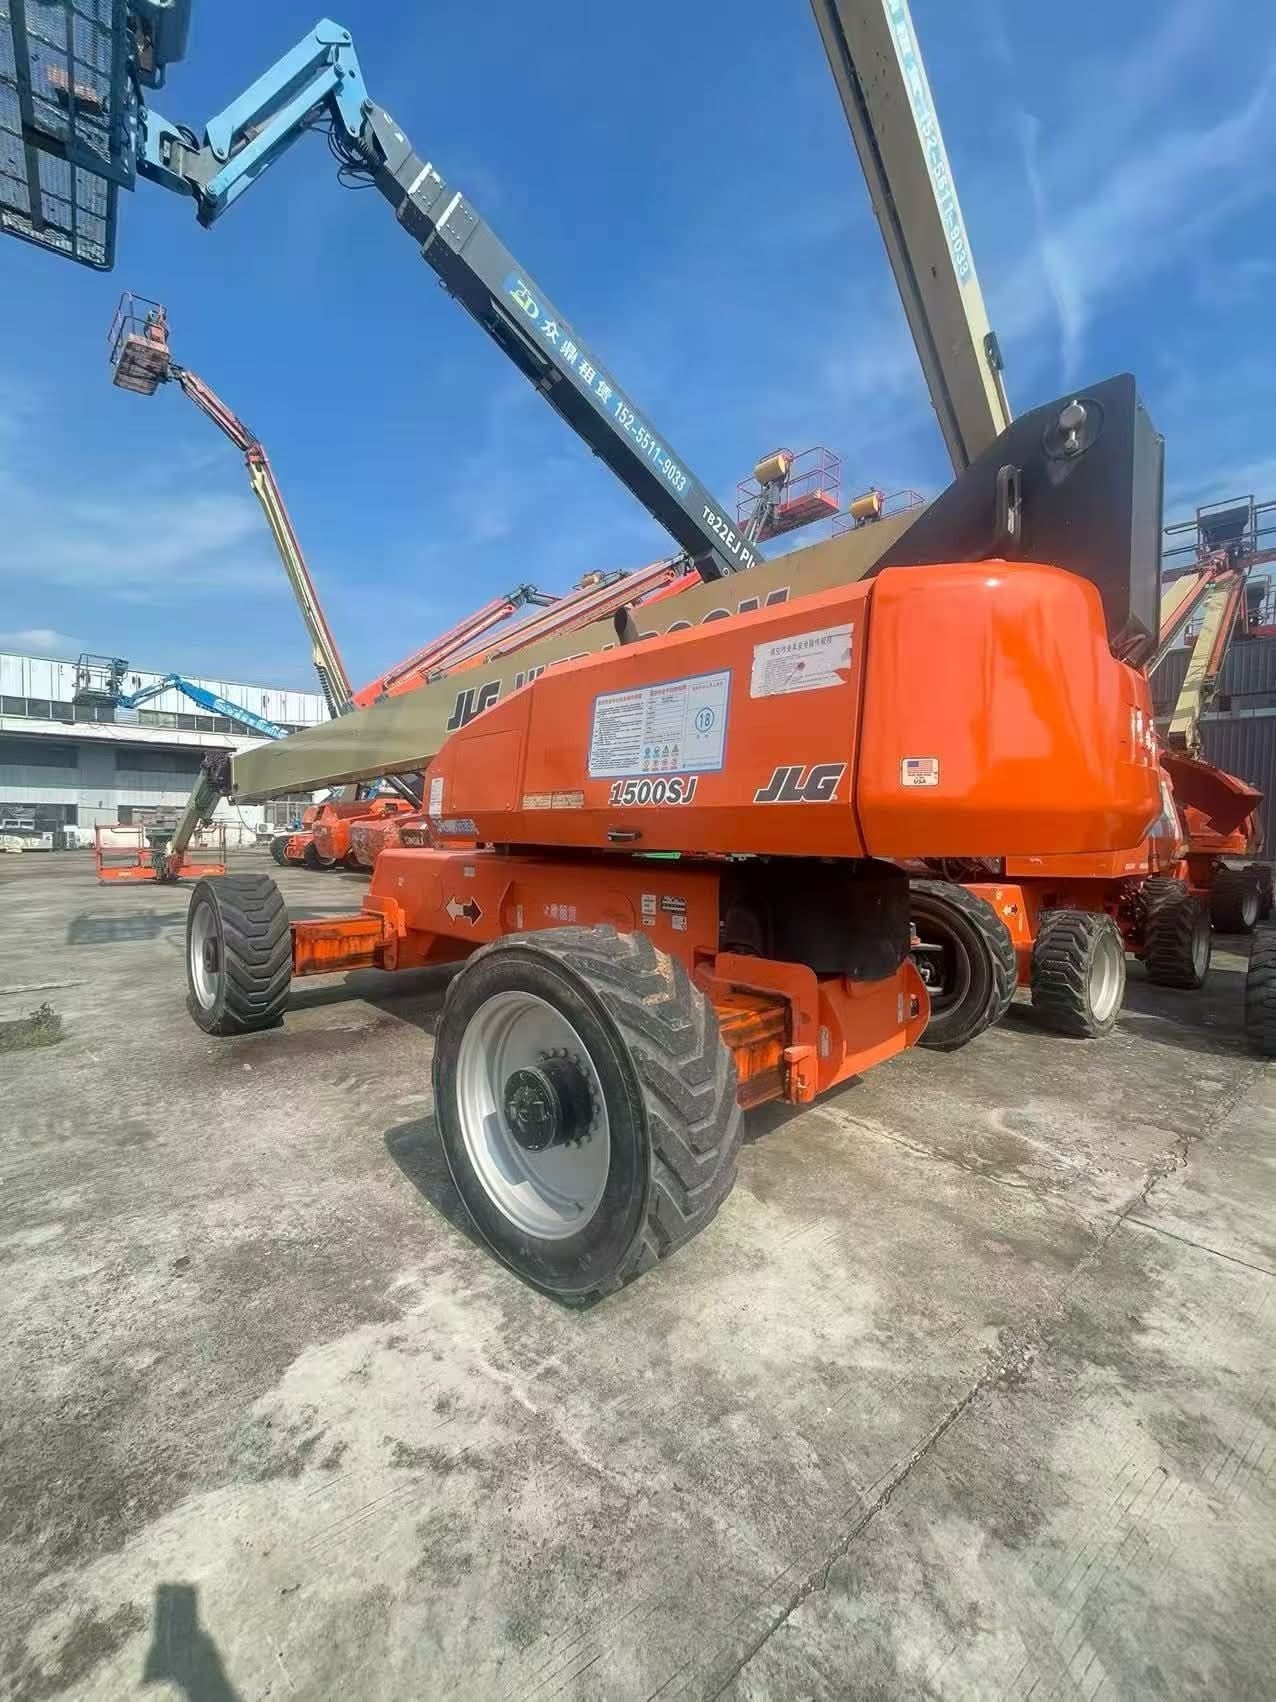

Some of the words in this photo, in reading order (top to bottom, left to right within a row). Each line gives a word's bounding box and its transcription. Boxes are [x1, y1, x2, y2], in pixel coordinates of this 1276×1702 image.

[614, 402, 687, 491] 152-5511-9033
[702, 505, 741, 553] TB22EJ
[447, 679, 502, 733] JLG
[699, 712, 711, 728] 18
[609, 776, 698, 807] 1500SJ
[753, 762, 847, 804] JLG
